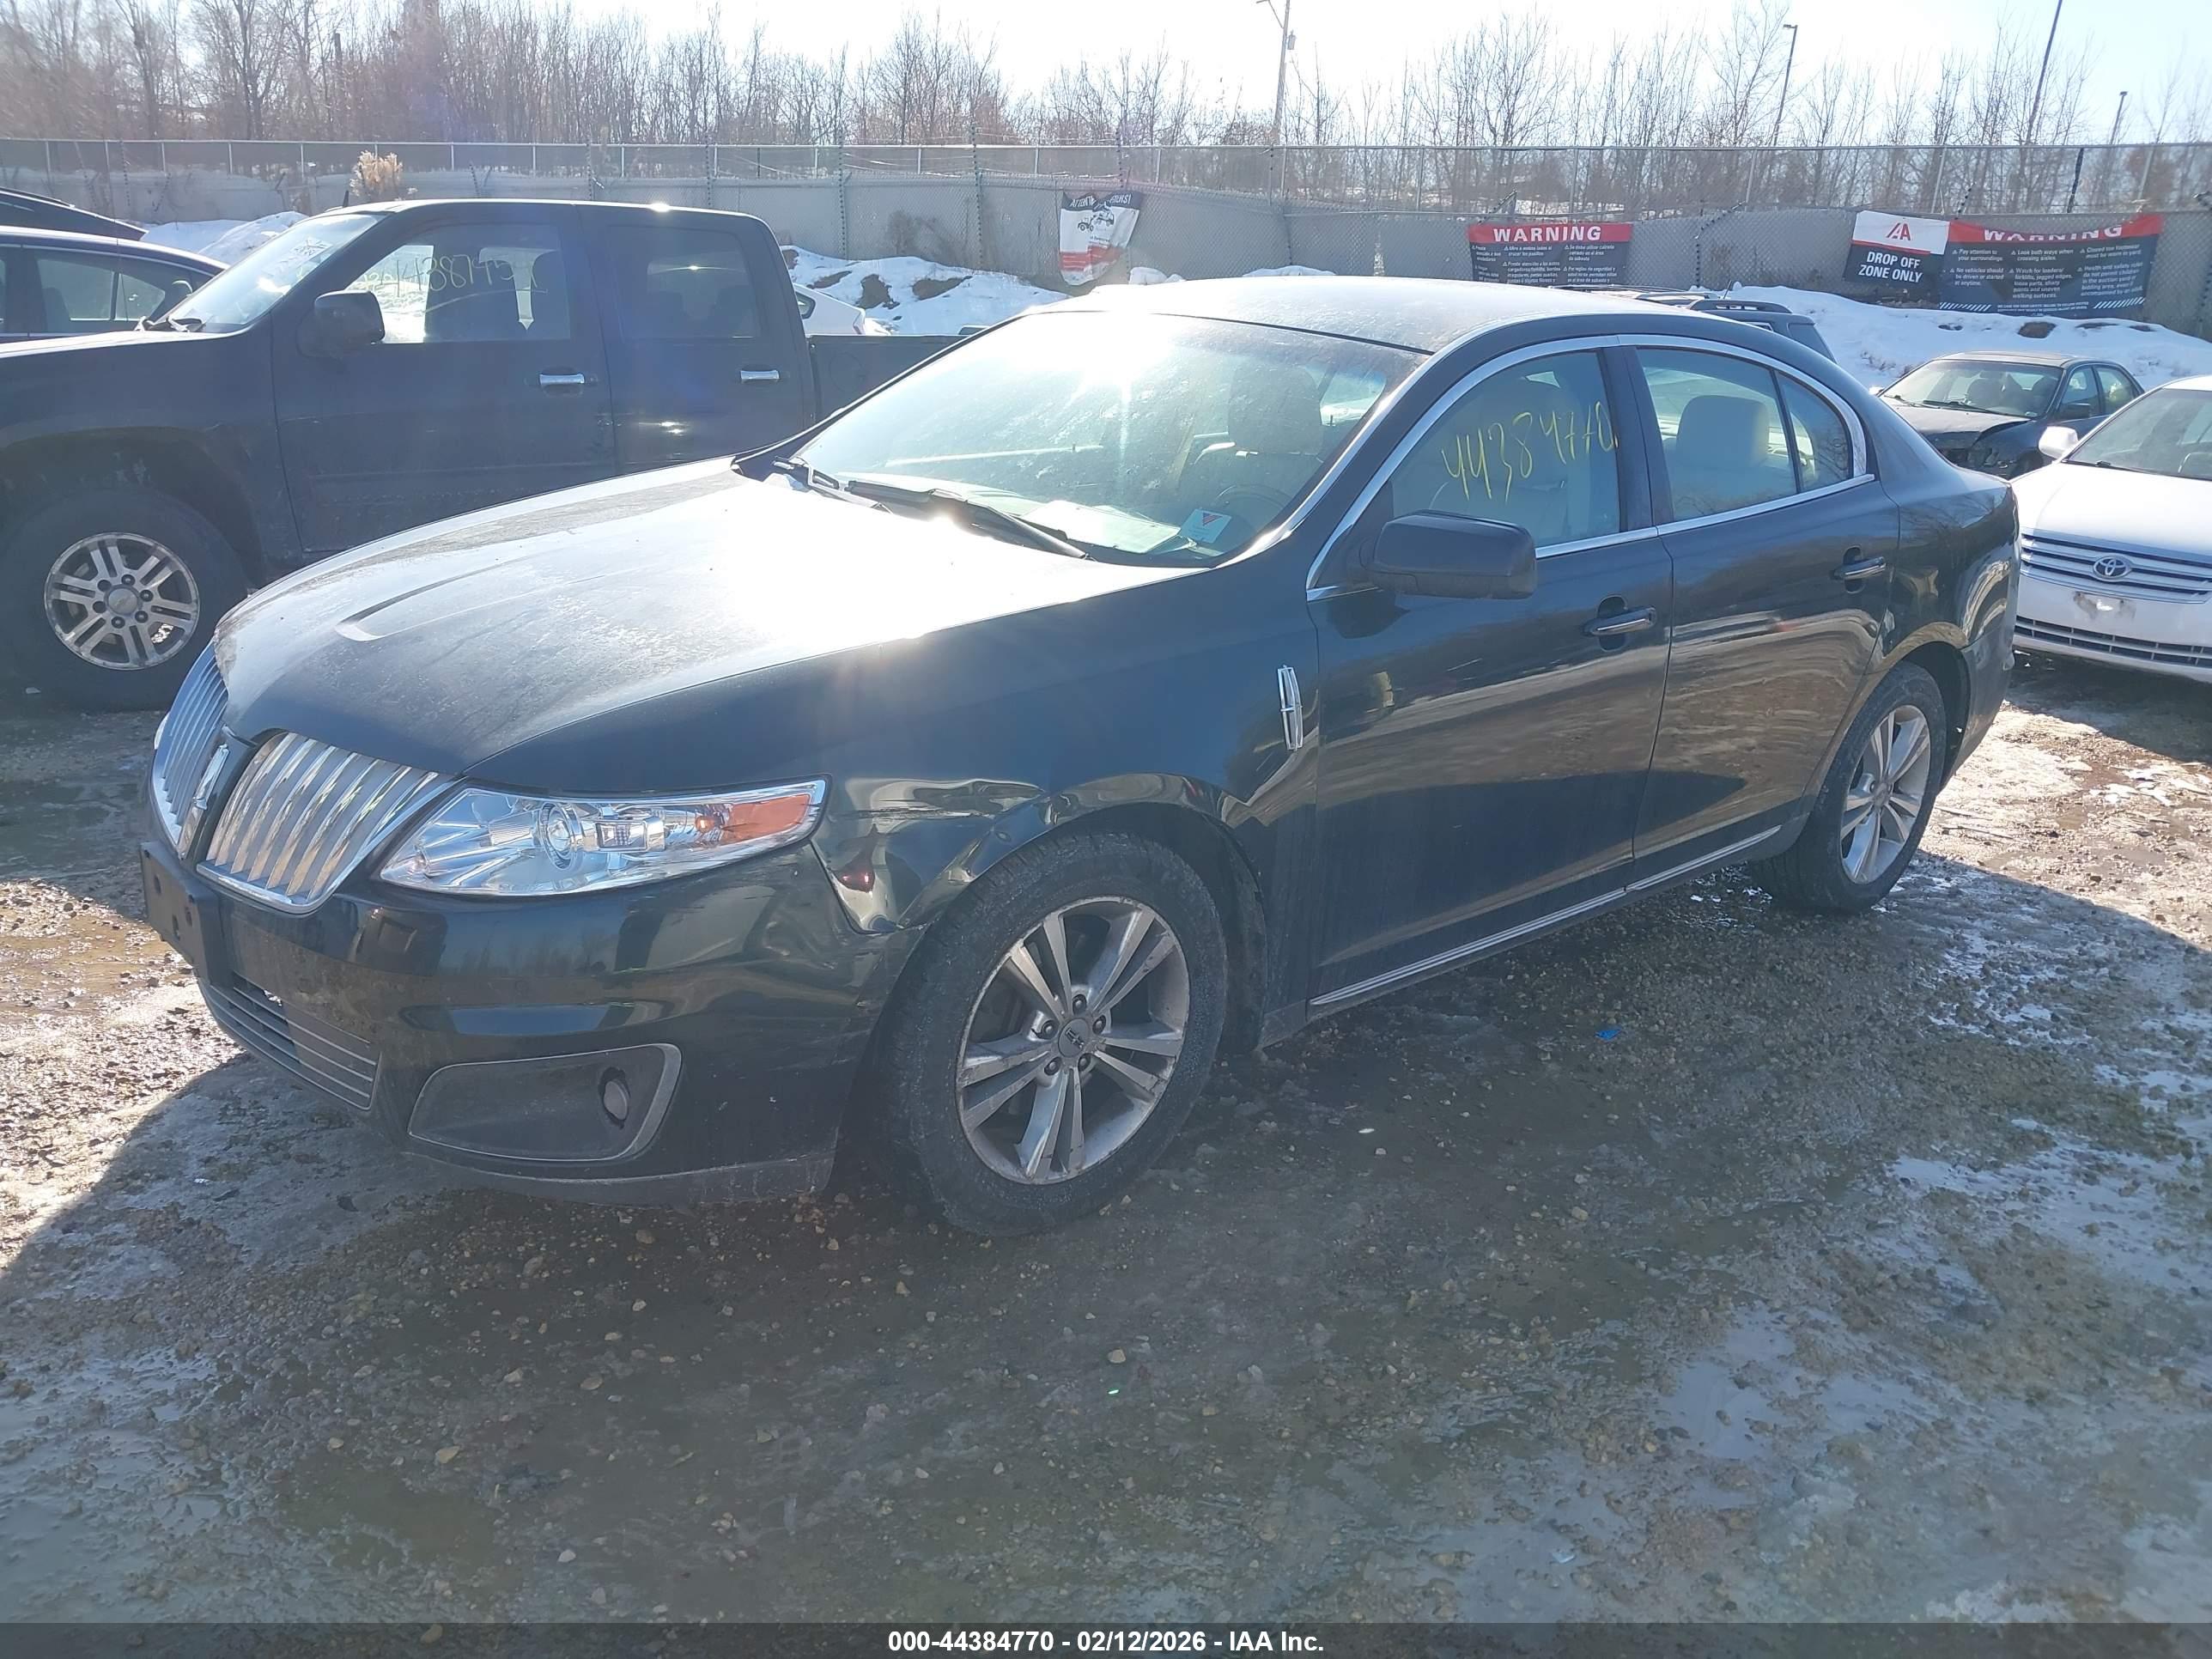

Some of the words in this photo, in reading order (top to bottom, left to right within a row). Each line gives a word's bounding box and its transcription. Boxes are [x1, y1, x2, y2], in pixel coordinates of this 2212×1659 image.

[1493, 226, 1602, 242] WARNING
[1866, 251, 1898, 266] DROP
[1900, 257, 1921, 269] OFF
[1858, 264, 1891, 279] ZONE
[1892, 269, 1923, 283] ONLY
